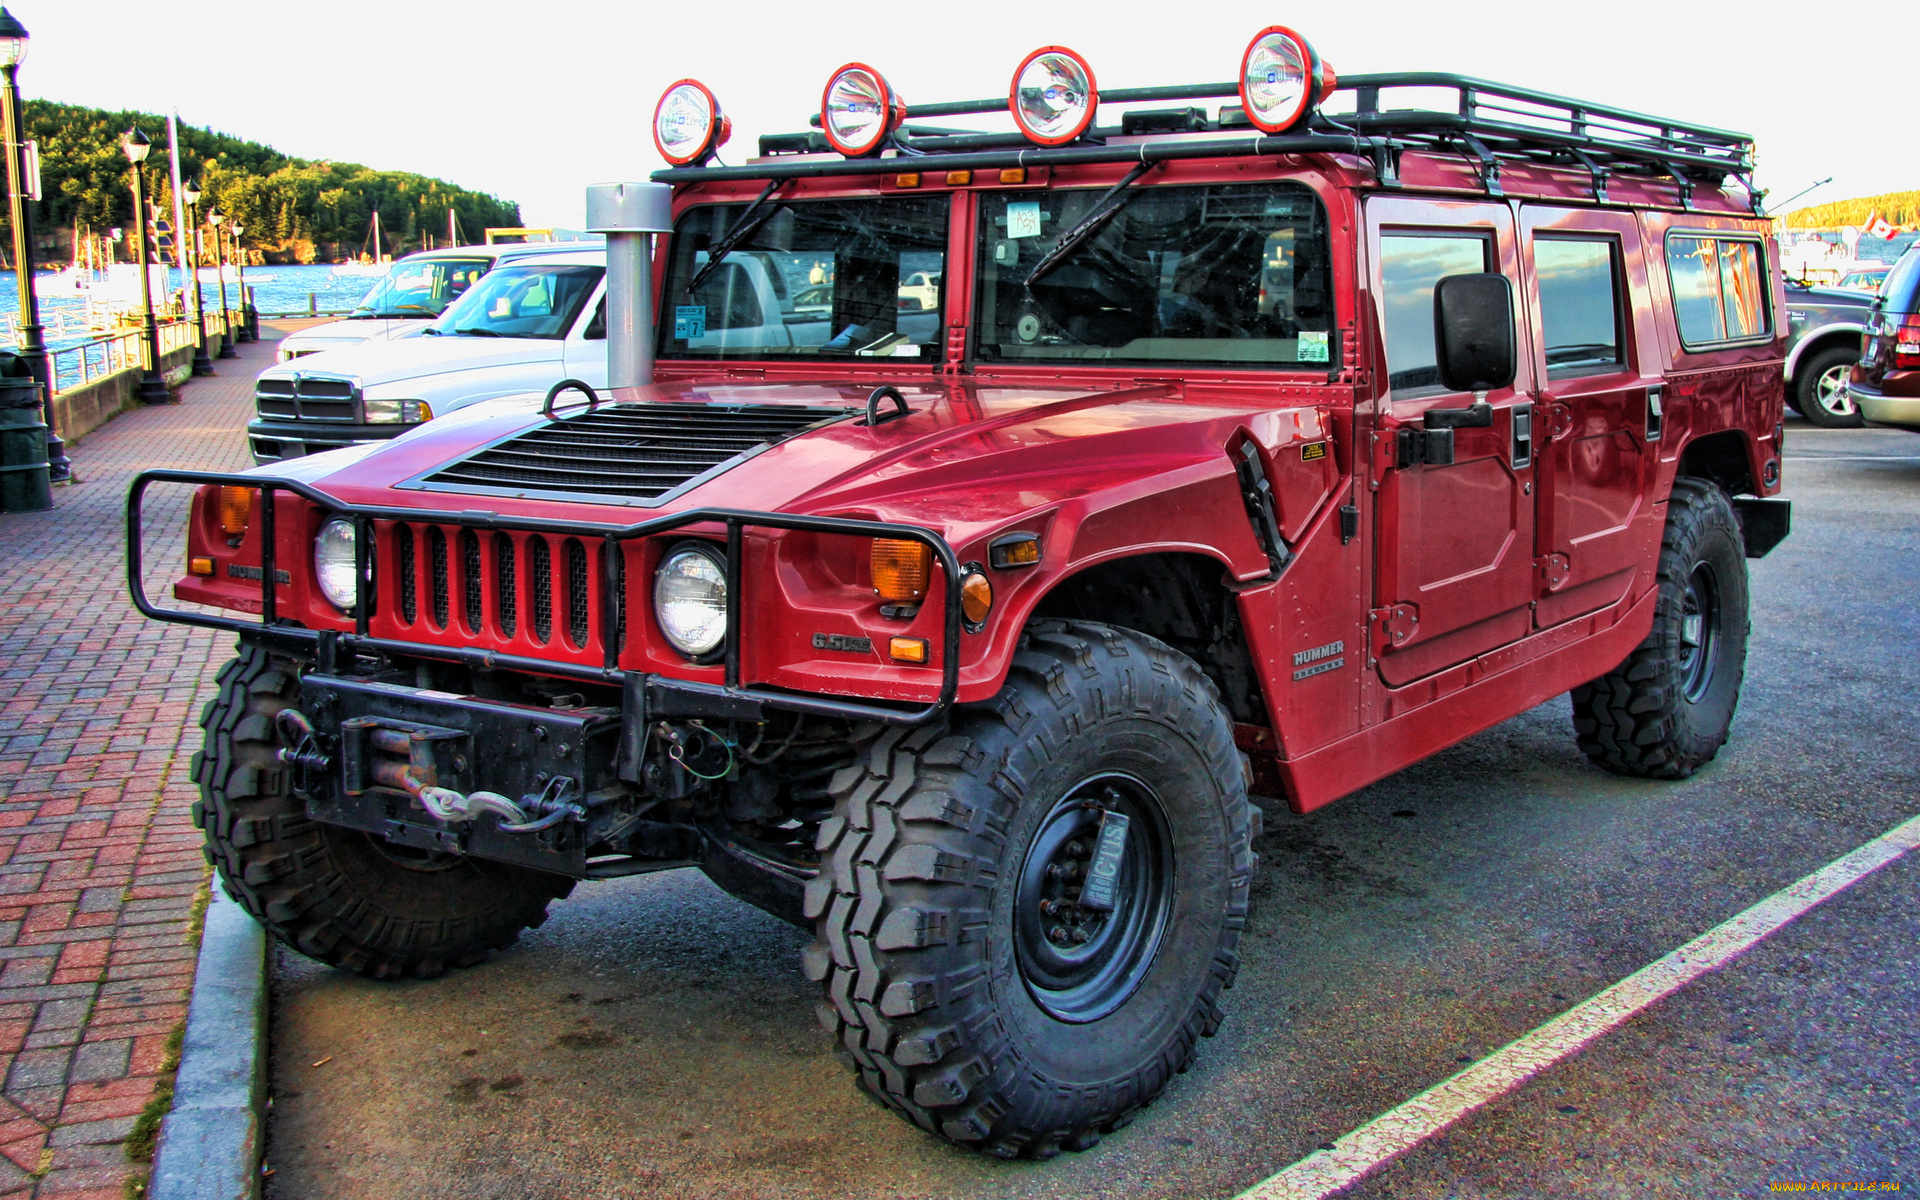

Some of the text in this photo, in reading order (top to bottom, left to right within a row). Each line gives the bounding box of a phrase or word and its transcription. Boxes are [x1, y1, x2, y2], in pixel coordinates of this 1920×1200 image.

[692, 321, 699, 336] 7
[1293, 640, 1344, 666] HUMMER
[1095, 825, 1125, 877] CTIS
